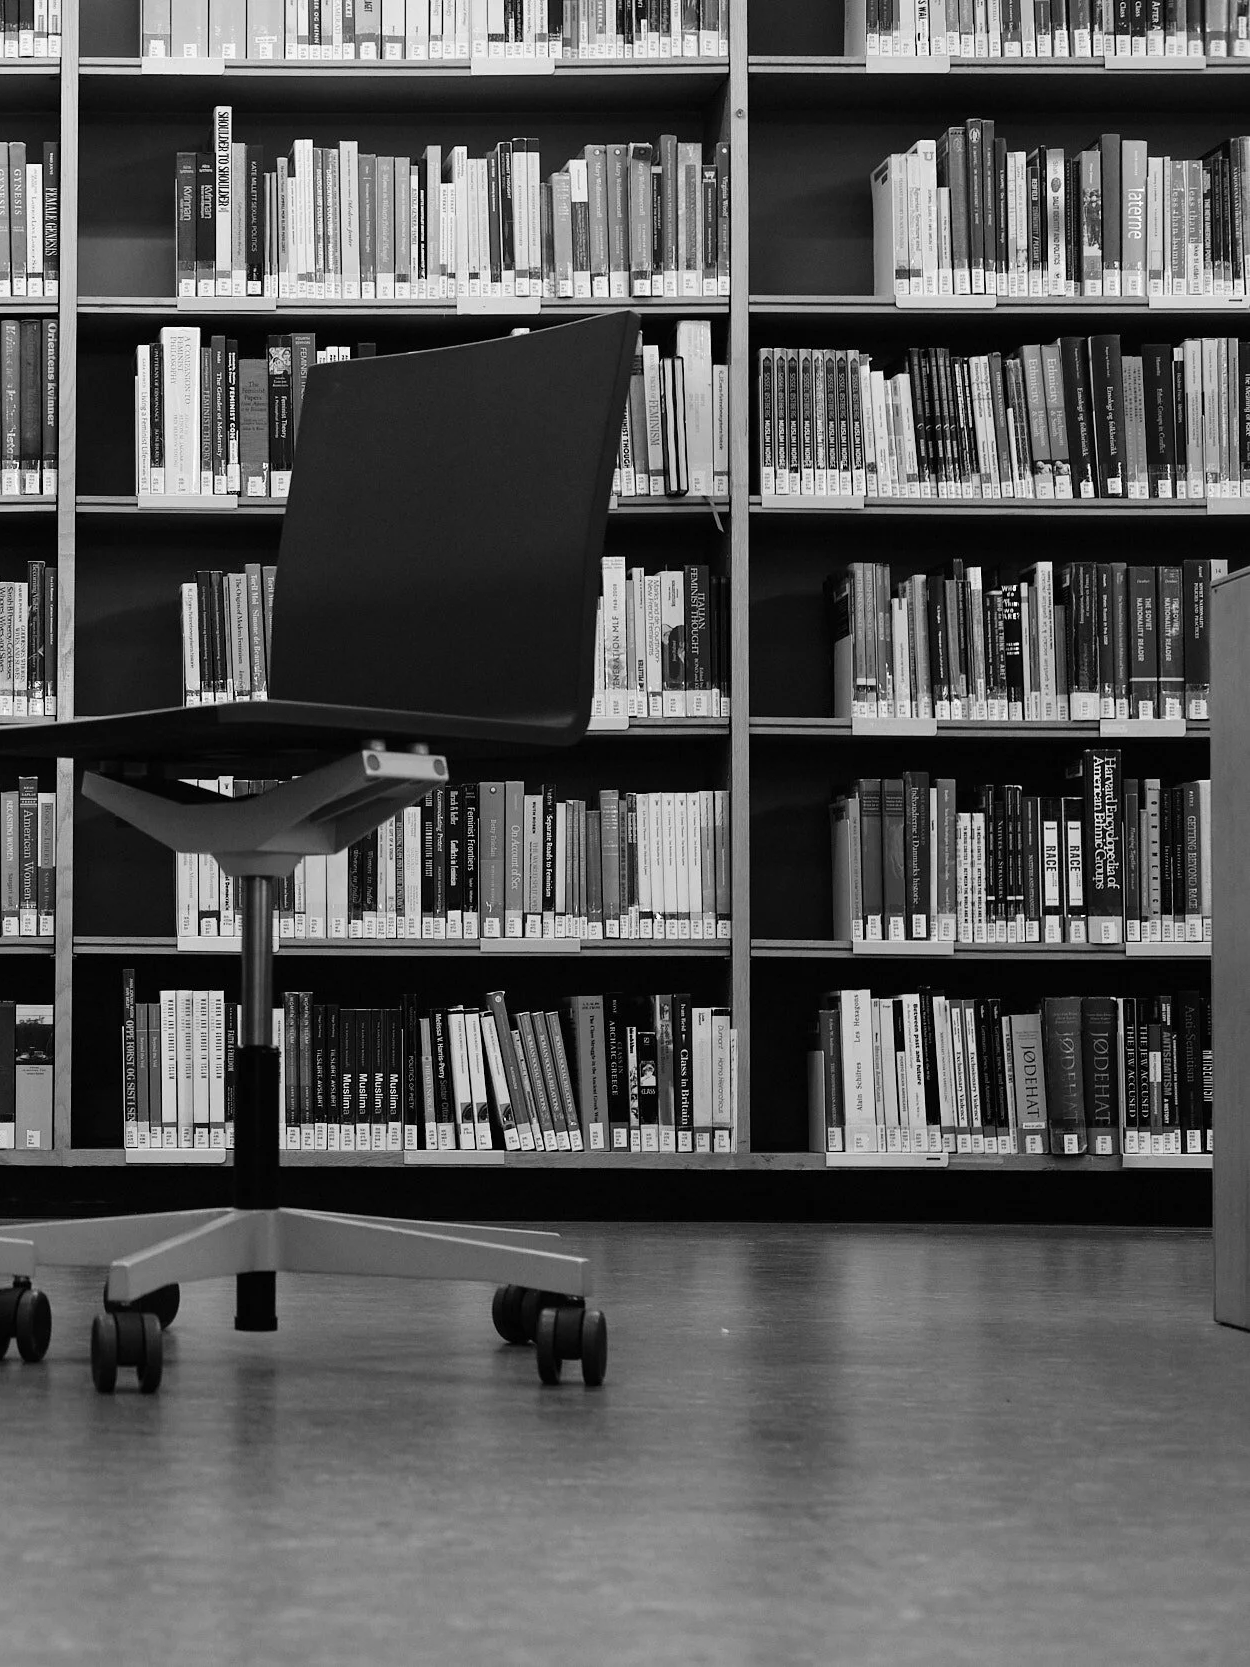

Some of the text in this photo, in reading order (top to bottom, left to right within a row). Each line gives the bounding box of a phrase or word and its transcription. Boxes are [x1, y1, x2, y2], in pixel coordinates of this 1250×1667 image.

[1152, 1, 1160, 24] AFTER
[218, 112, 228, 206] SHOULDER TO SHOULDER
[46, 187, 57, 256] FEMALE GENESIS
[183, 186, 192, 220] Kvinnan
[1128, 187, 1145, 239] Taterne
[47, 323, 56, 426] Orientens kvinner
[1029, 358, 1038, 404] Ethnicity
[649, 400, 659, 446] FEMINISM
[1093, 756, 1105, 889] American Ethnic Groups
[1104, 757, 1120, 888] Harvard Encyclopedia of
[24, 810, 33, 899] American Women
[511, 825, 519, 889] On Account of Sex
[1046, 846, 1056, 872] RACE
[1070, 846, 1080, 872] RACE
[1188, 816, 1197, 908] GETTING BEYOND RACE
[126, 1020, 135, 1040] OPPE
[126, 1042, 135, 1065] FØRST
[437, 1044, 445, 1078] Harris-Perry
[609, 1021, 618, 1095] ARCHAIC GREECE
[1185, 1006, 1196, 1082] Anti-Semitism
[126, 1068, 135, 1080] OG
[126, 1082, 135, 1100] SIST
[342, 1074, 352, 1114] Muslima
[359, 1074, 368, 1114] Muslima
[680, 1049, 689, 1125] Class in Britain
[1021, 1046, 1039, 1117] JØDEHAT
[1092, 1032, 1110, 1124] JØDEHAT
[1126, 1024, 1136, 1117] THE JEW ACCUSED
[1163, 1032, 1171, 1095] ANTISEMITISM
